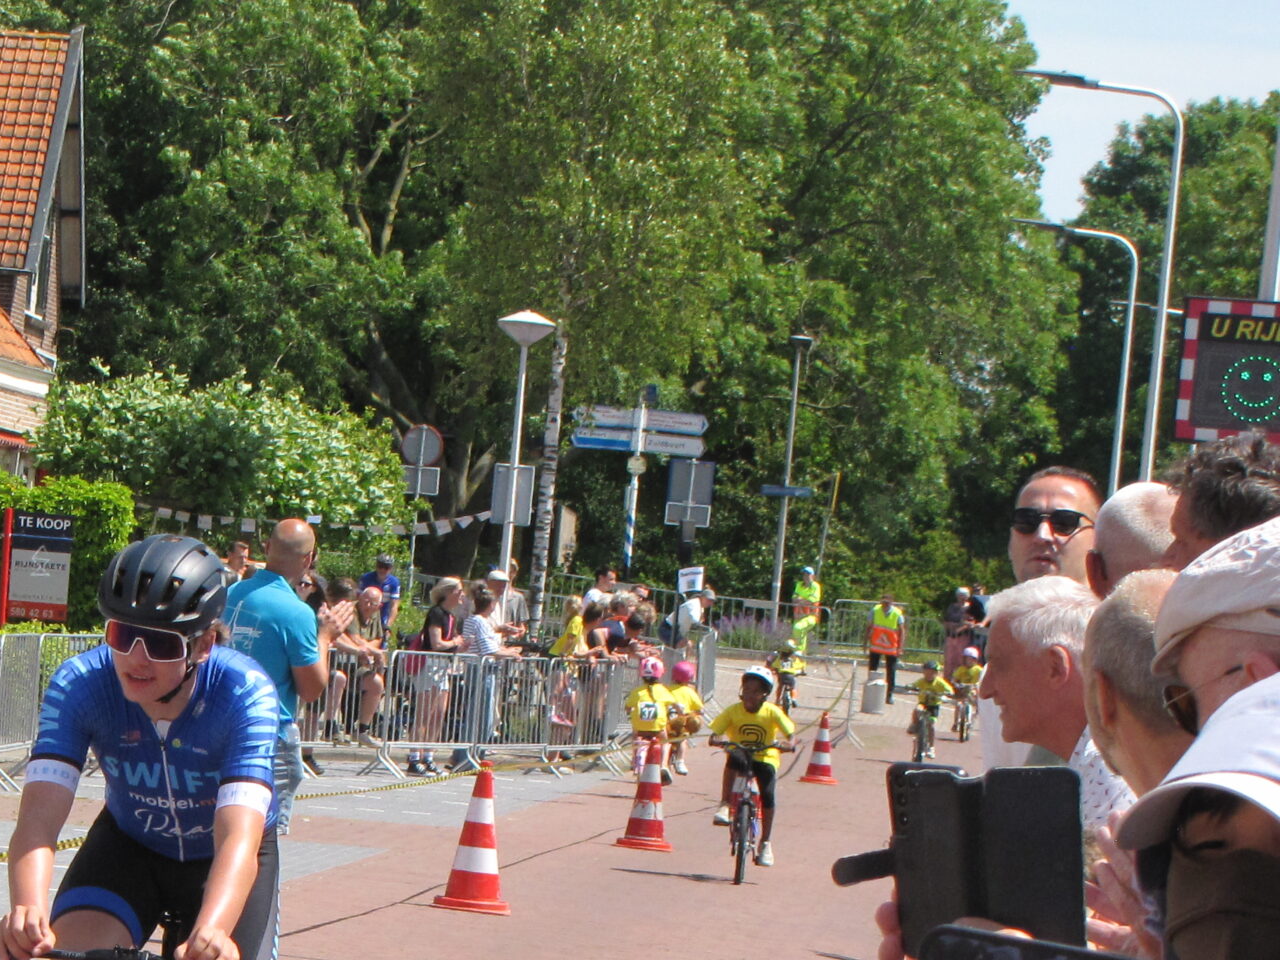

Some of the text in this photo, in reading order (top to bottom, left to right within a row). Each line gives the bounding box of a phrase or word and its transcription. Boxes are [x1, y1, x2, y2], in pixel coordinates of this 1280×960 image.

[1211, 317, 1231, 338] U
[19, 516, 71, 531] TE KOOP
[29, 609, 39, 617] 42
[641, 707, 656, 720] 37
[103, 756, 220, 794] SWIFT
